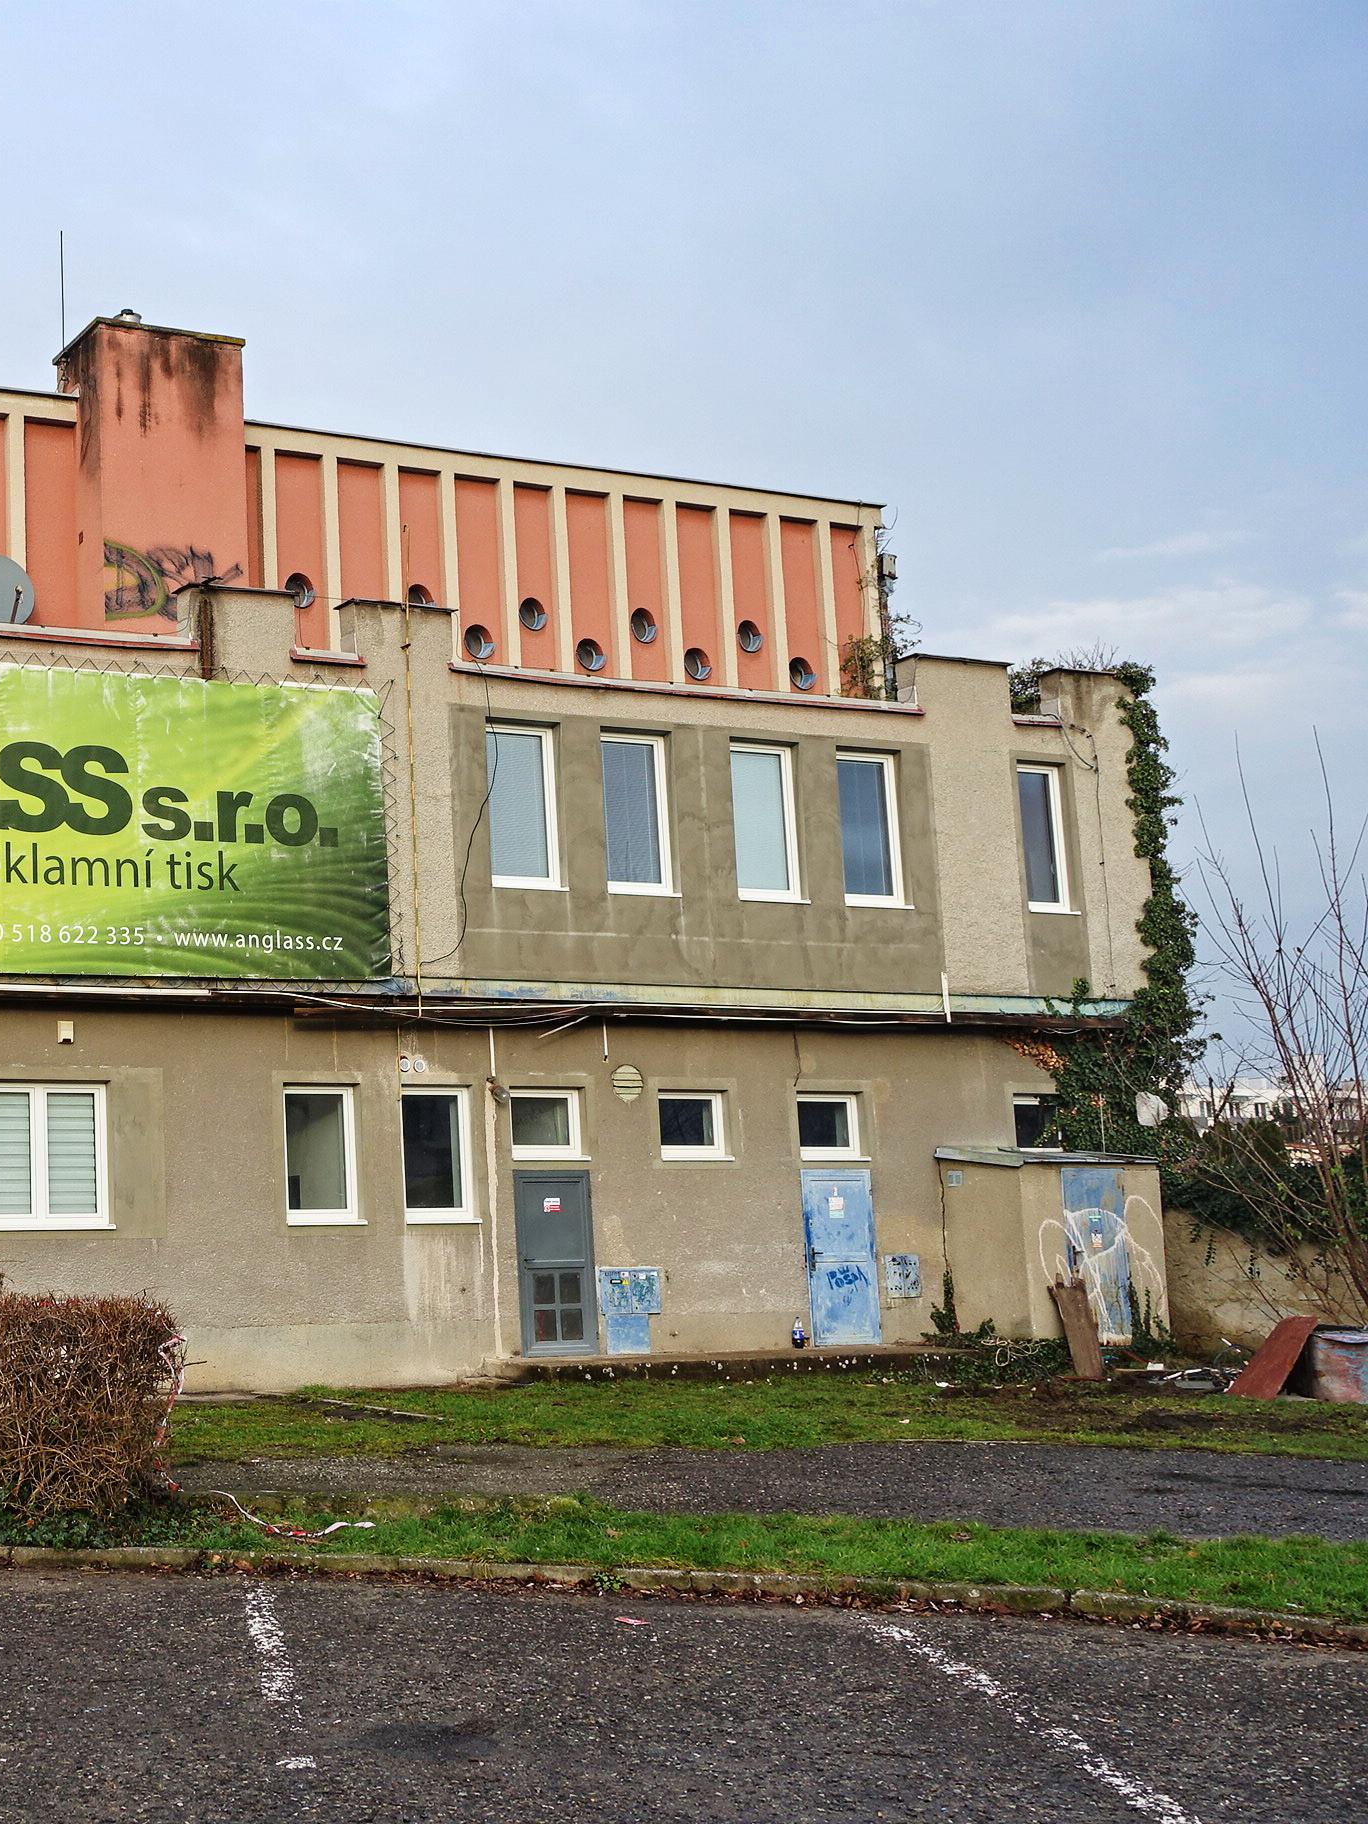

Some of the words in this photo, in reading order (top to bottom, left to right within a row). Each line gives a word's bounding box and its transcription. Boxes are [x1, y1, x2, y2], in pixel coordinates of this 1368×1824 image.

[141, 786, 339, 848] s.r.o.
[166, 851, 241, 891] tisk
[12, 923, 52, 943] 518
[58, 925, 98, 944] 622
[106, 926, 145, 945] 335
[174, 930, 344, 953] www.anglass.cz
